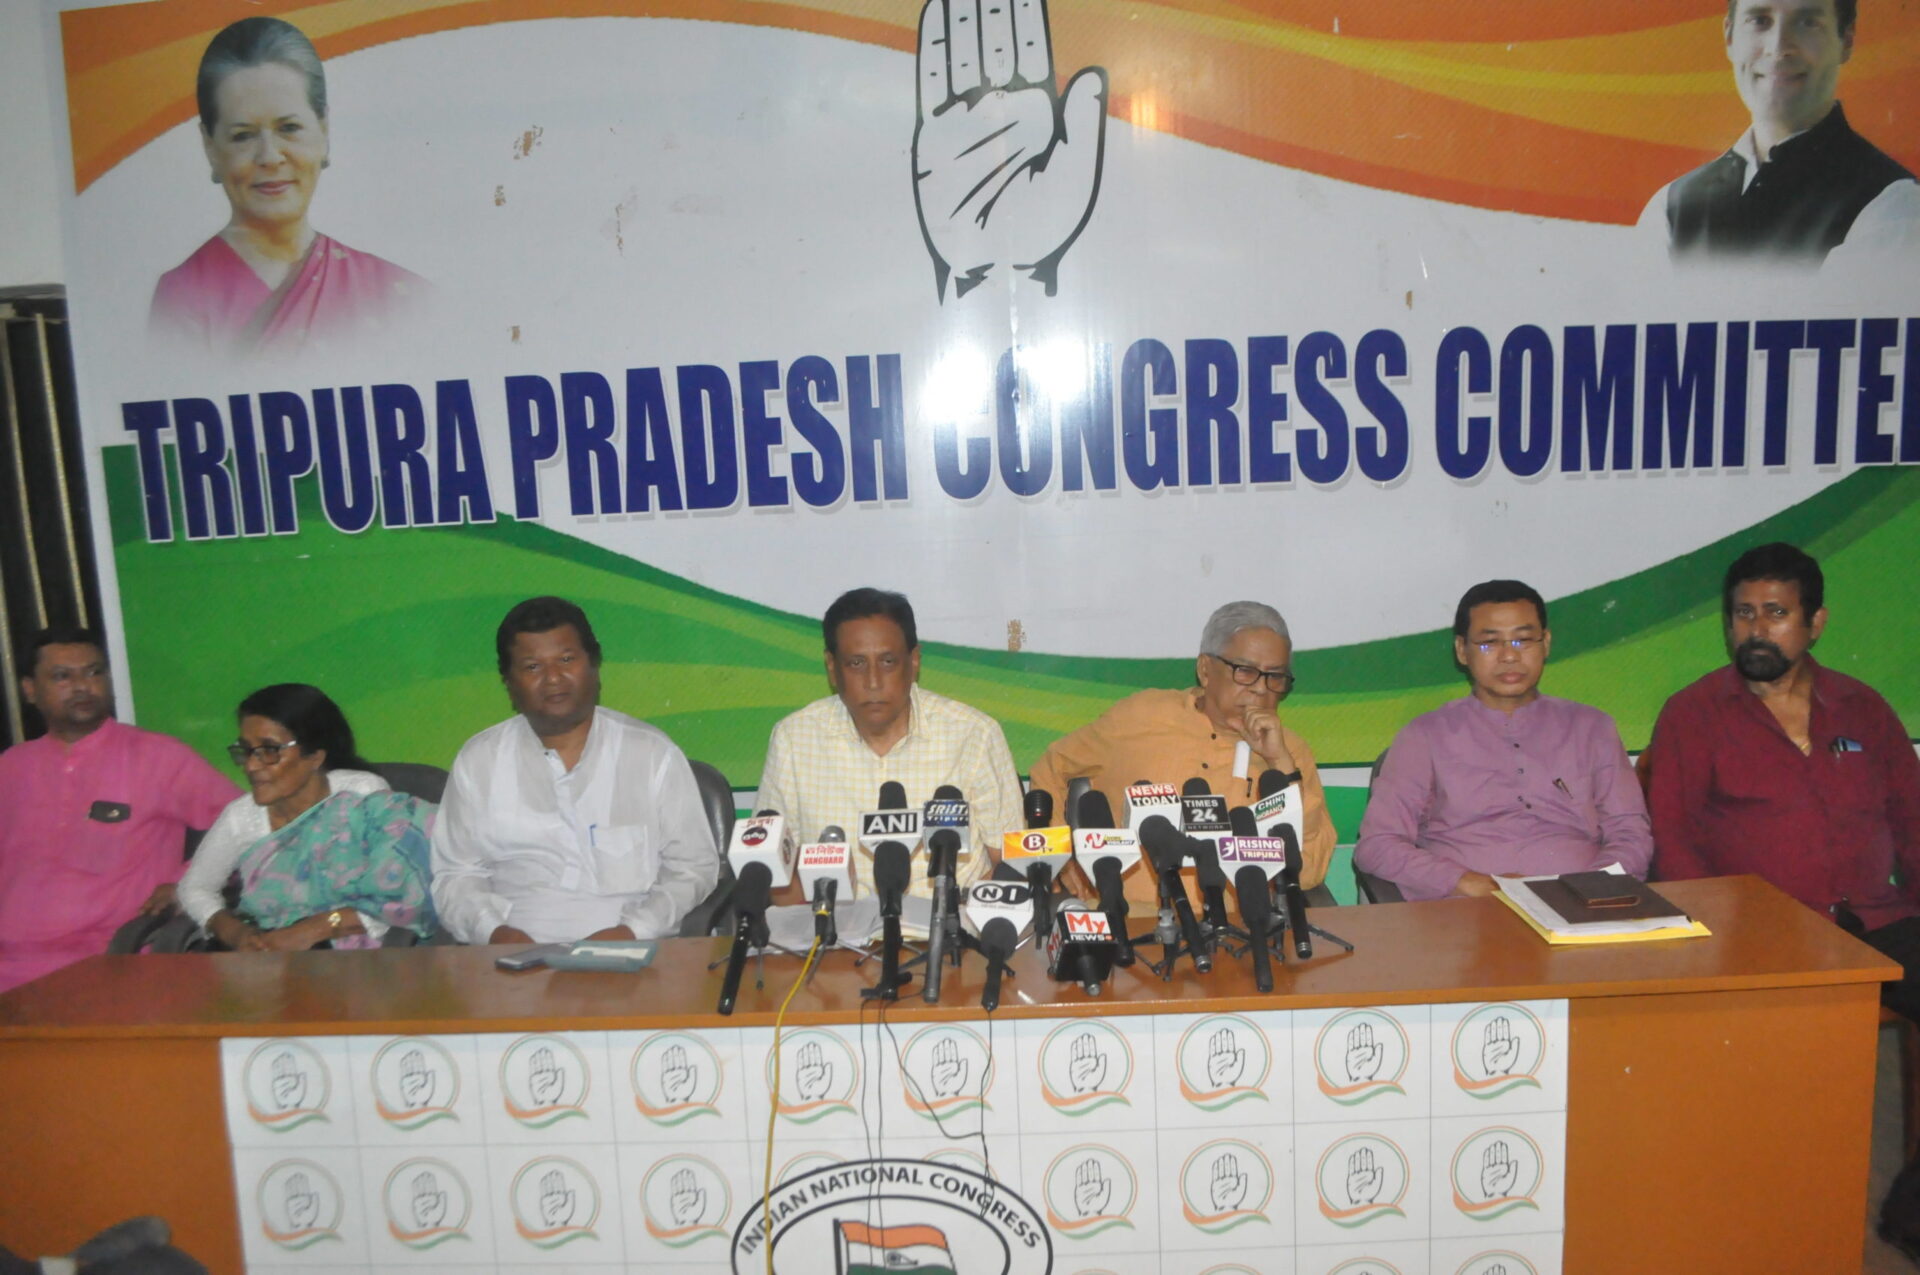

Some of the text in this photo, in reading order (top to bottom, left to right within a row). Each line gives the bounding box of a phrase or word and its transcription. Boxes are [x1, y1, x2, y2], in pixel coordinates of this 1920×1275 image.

[121, 378, 496, 542] TRIPURA
[504, 352, 910, 519] PRADESH
[932, 327, 1410, 500] CONGRESS
[1130, 784, 1174, 796] NEWS
[1133, 795, 1176, 806] TODAY
[1184, 799, 1218, 807] TIMES
[1191, 808, 1218, 822] 24
[866, 813, 915, 834] ANI
[1027, 835, 1042, 847] B
[1239, 839, 1281, 849] RISING
[803, 856, 844, 864] VANGUARD
[739, 1166, 1041, 1255] INDIAN NATIONAL CONGRESS
